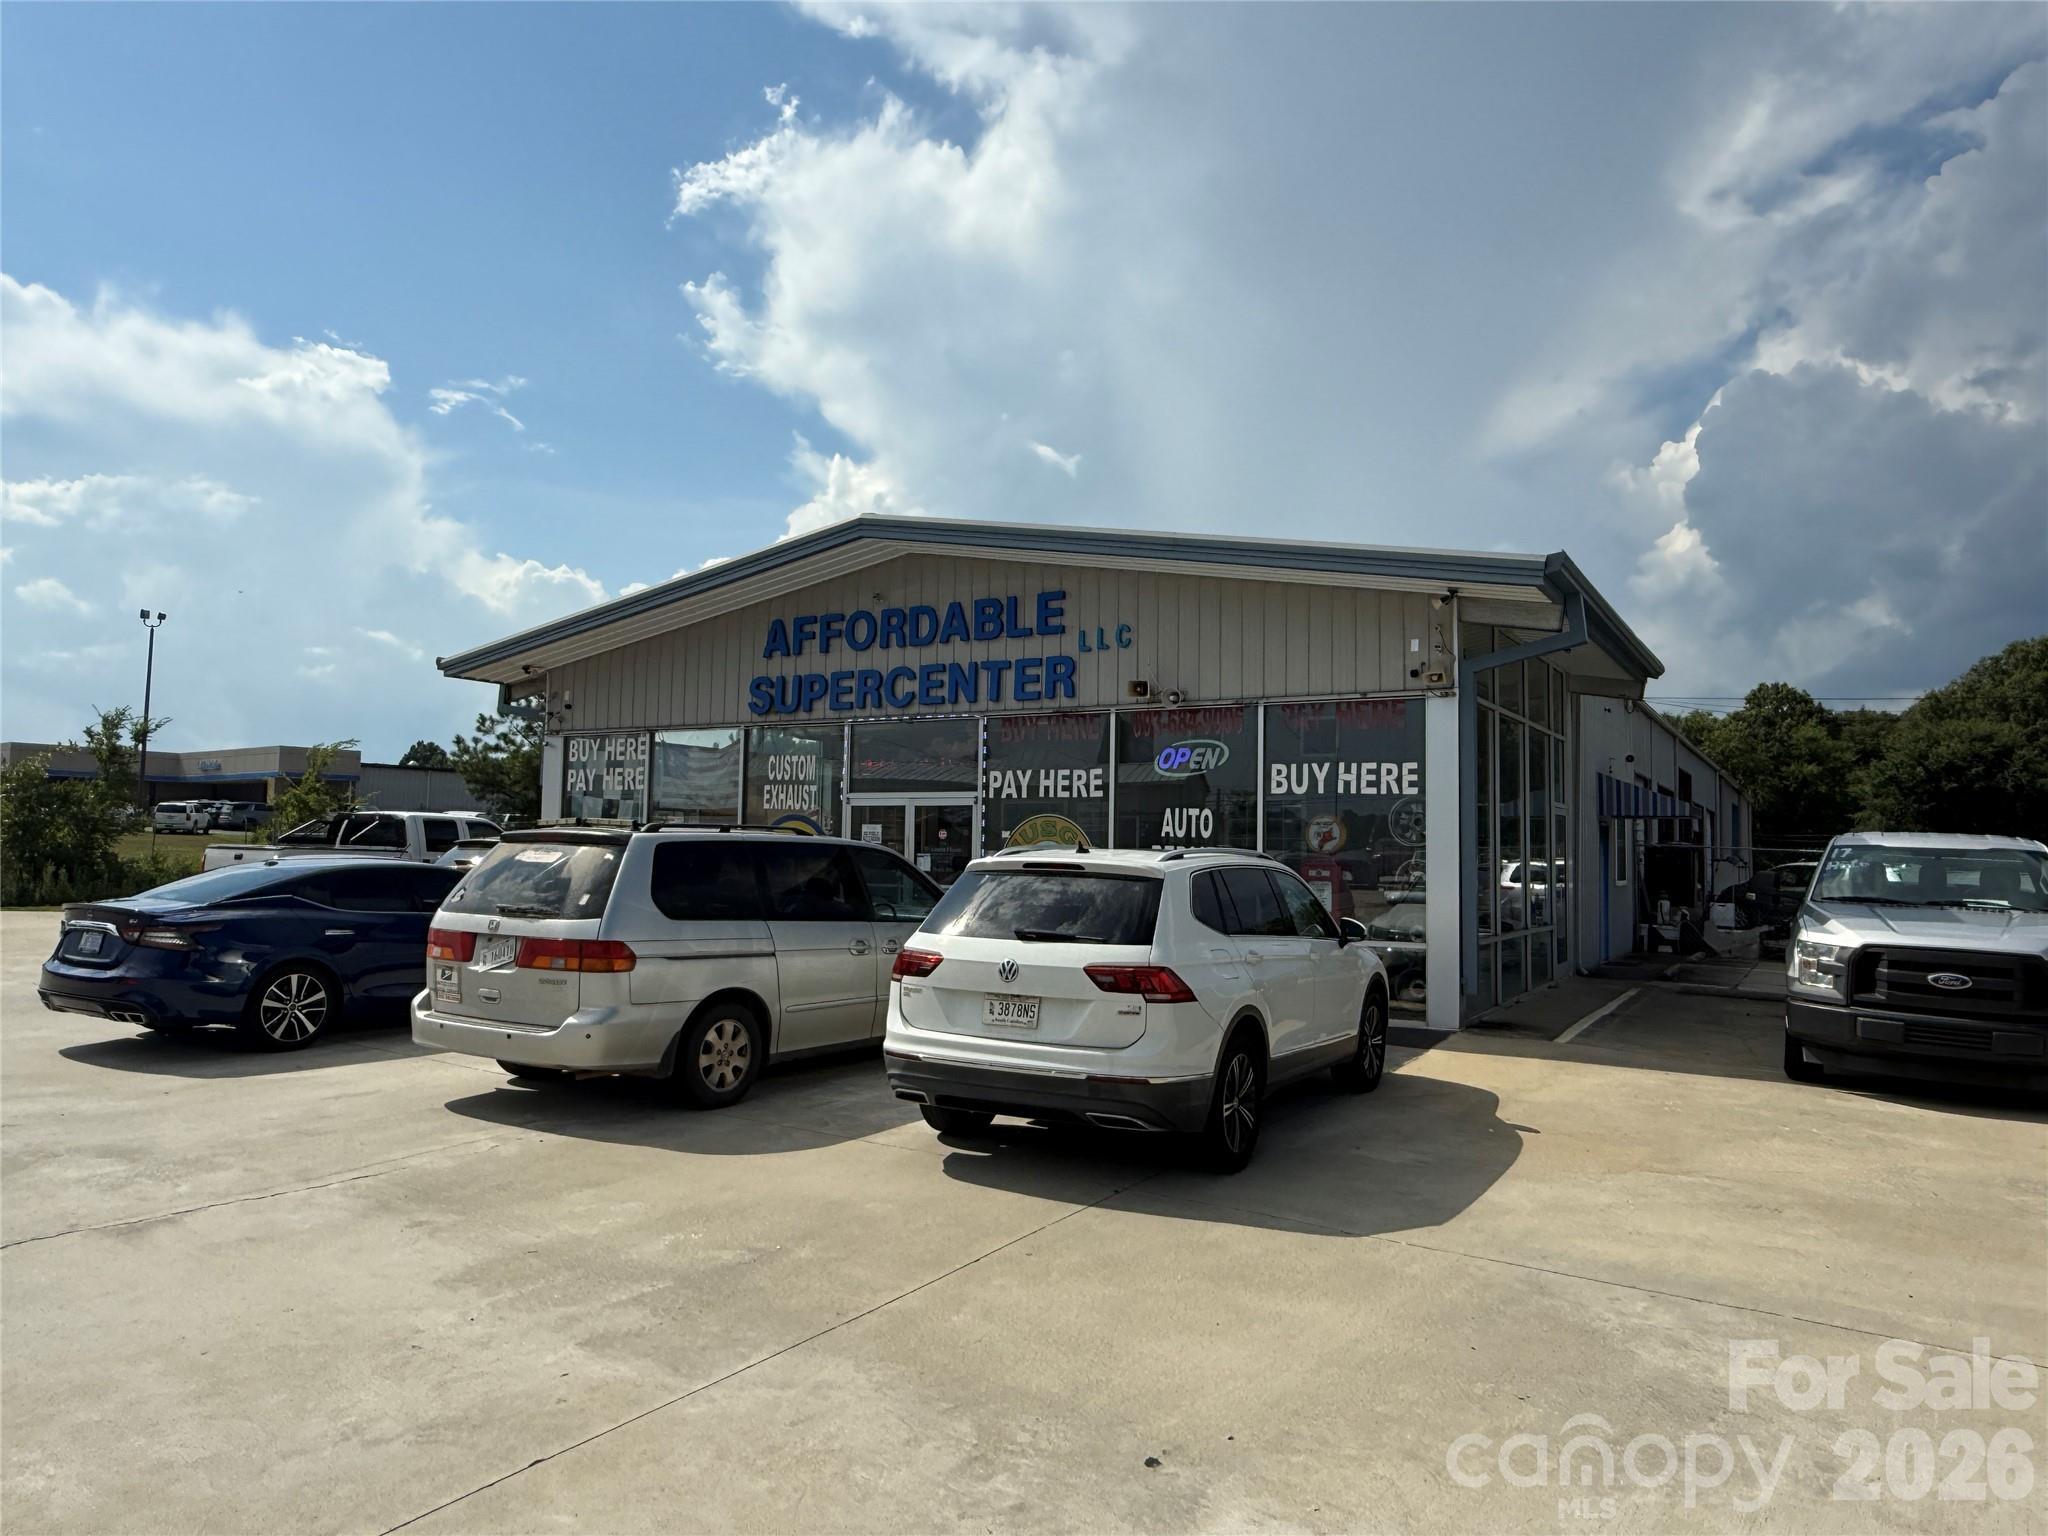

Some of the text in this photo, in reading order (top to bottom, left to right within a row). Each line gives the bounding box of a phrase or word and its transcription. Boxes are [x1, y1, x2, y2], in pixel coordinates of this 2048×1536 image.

[763, 590, 1066, 659] AFFORDABLE
[1079, 624, 1132, 652] LLC
[748, 655, 1075, 715] SUPERCENTER
[569, 736, 646, 762] BUY HERE
[1159, 747, 1221, 769] OPEN
[567, 767, 645, 791] PAY HERE
[768, 755, 816, 780] CUSTOM
[1270, 762, 1419, 794] BUY HERE
[763, 784, 818, 810] EXHAUST
[988, 768, 1104, 799] PAY HERE
[1161, 808, 1213, 839] AUTO
[998, 1001, 1037, 1019] 3878NS
